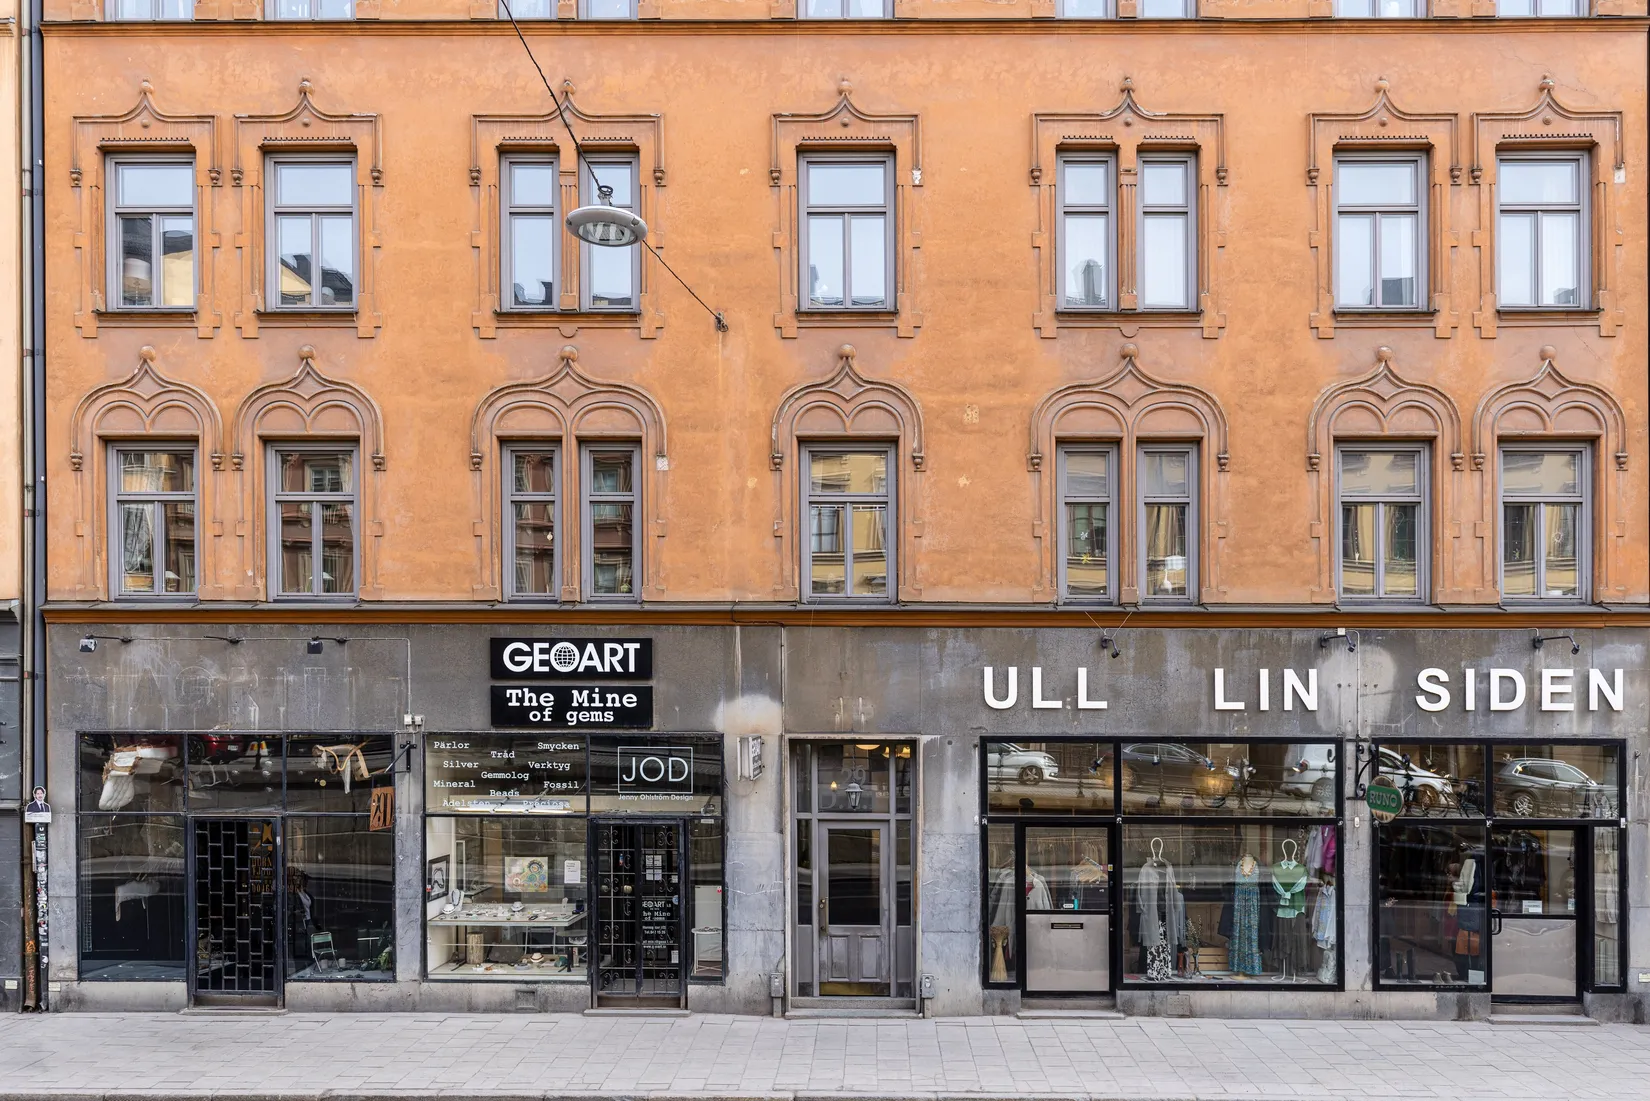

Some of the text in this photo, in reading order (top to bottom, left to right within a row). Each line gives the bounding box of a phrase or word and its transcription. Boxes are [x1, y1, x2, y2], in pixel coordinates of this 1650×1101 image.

[503, 642, 640, 672] GEOART
[984, 666, 1624, 711] ULL LIN SIDEN
[506, 688, 637, 707] The Mine
[529, 707, 614, 725] of gems
[434, 741, 470, 749] Pärlor
[537, 742, 580, 751] Smycken
[490, 750, 515, 758] Tråd
[528, 761, 571, 771] Verktyg
[622, 756, 689, 781] JOD
[481, 771, 530, 781] Gemmolog
[433, 780, 476, 788] Mineral
[543, 781, 580, 789] Fossil
[489, 789, 520, 797] Beads
[1369, 790, 1398, 808] RUNO
